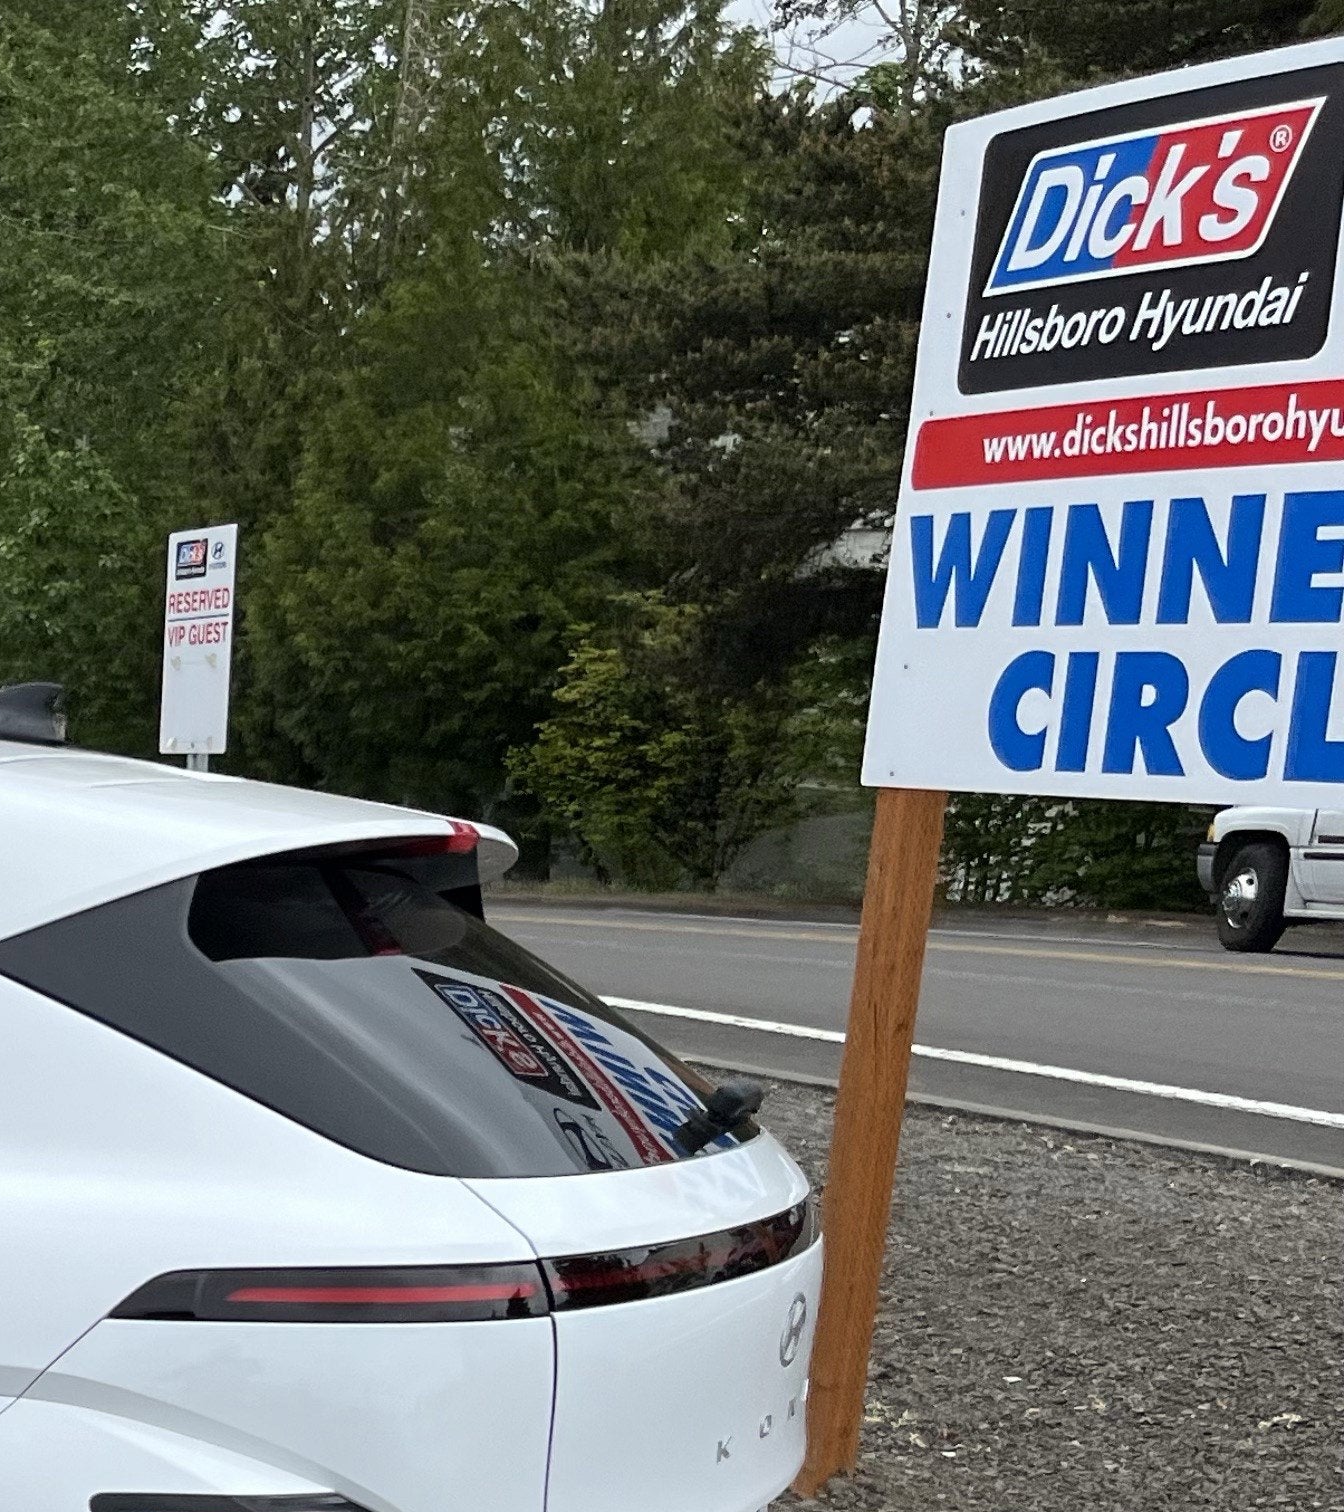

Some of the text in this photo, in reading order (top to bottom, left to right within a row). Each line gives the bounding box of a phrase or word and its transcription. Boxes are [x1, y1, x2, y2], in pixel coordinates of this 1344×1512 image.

[1006, 129, 1272, 272] Dick's
[969, 271, 1311, 362] Hillsboro Hyundai
[982, 392, 1344, 465] www.dickshillsborohyu
[168, 587, 231, 615] RESERVED
[909, 490, 1344, 629] WINNE
[167, 621, 229, 648] VIP GUEST
[987, 648, 1344, 784] CIRCL
